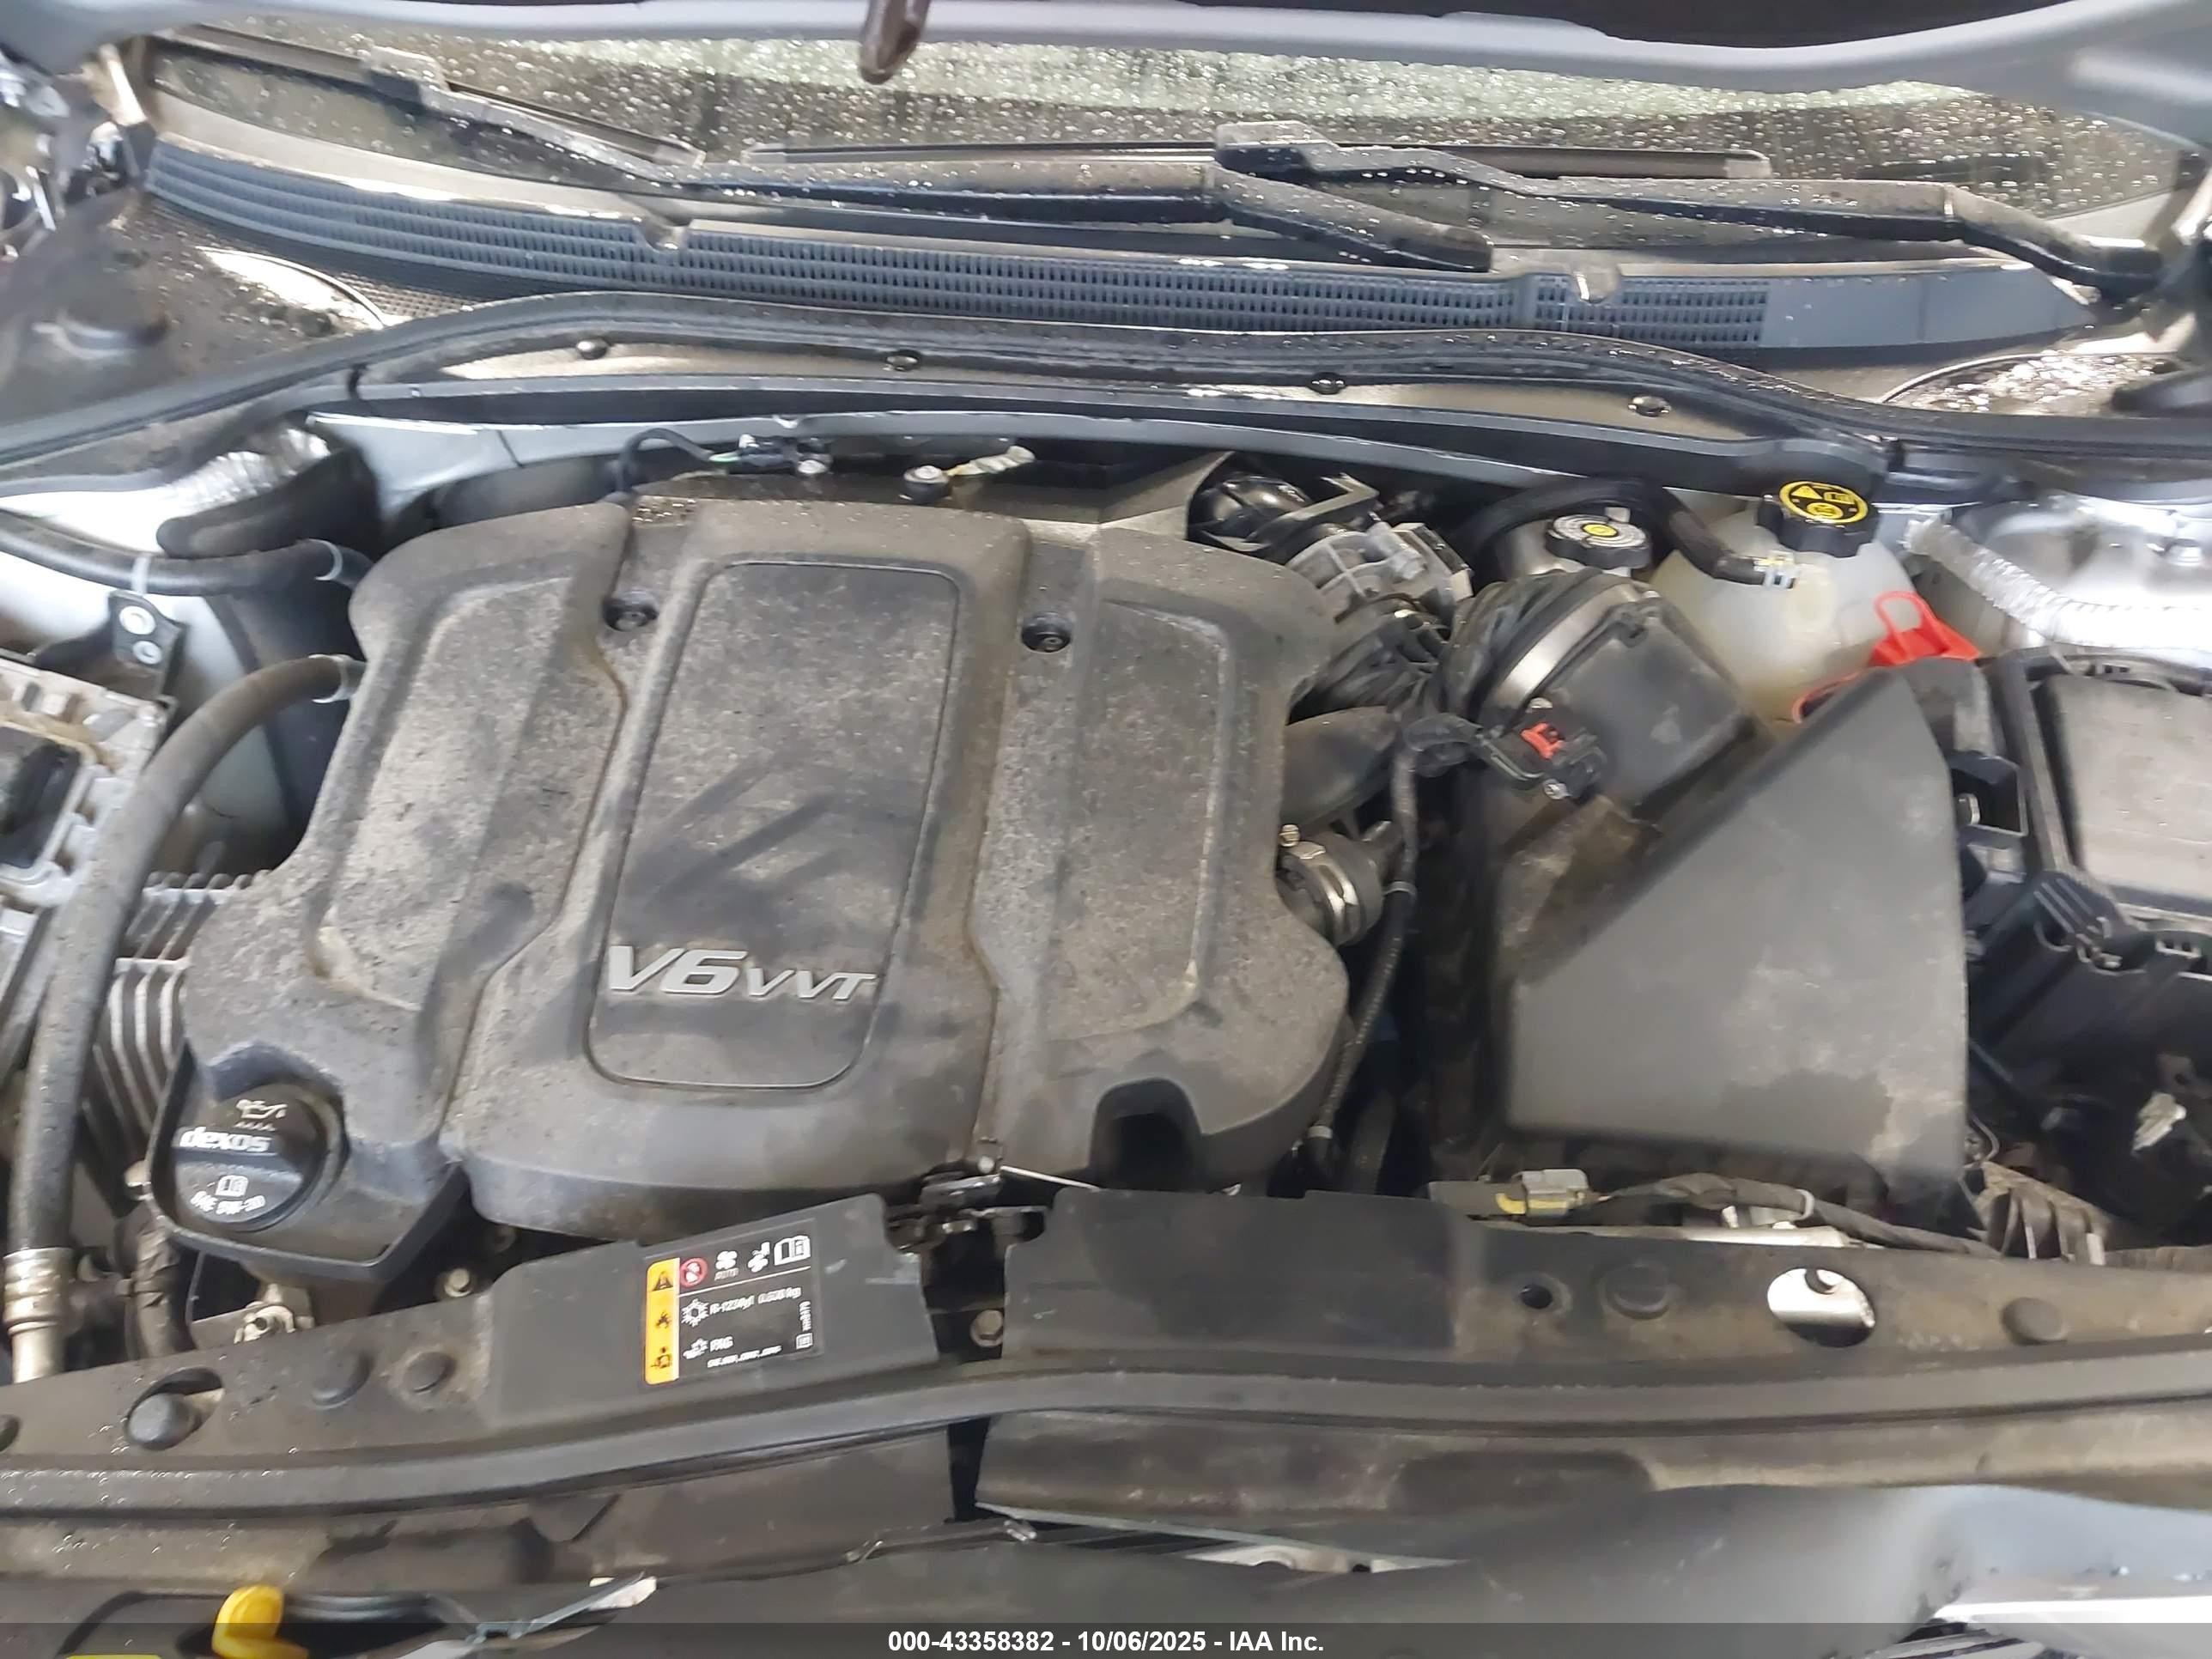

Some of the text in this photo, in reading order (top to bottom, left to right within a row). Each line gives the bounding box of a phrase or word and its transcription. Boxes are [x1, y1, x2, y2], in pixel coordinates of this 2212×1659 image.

[609, 945, 877, 1000] V6 VVT
[179, 1127, 272, 1152] dexos
